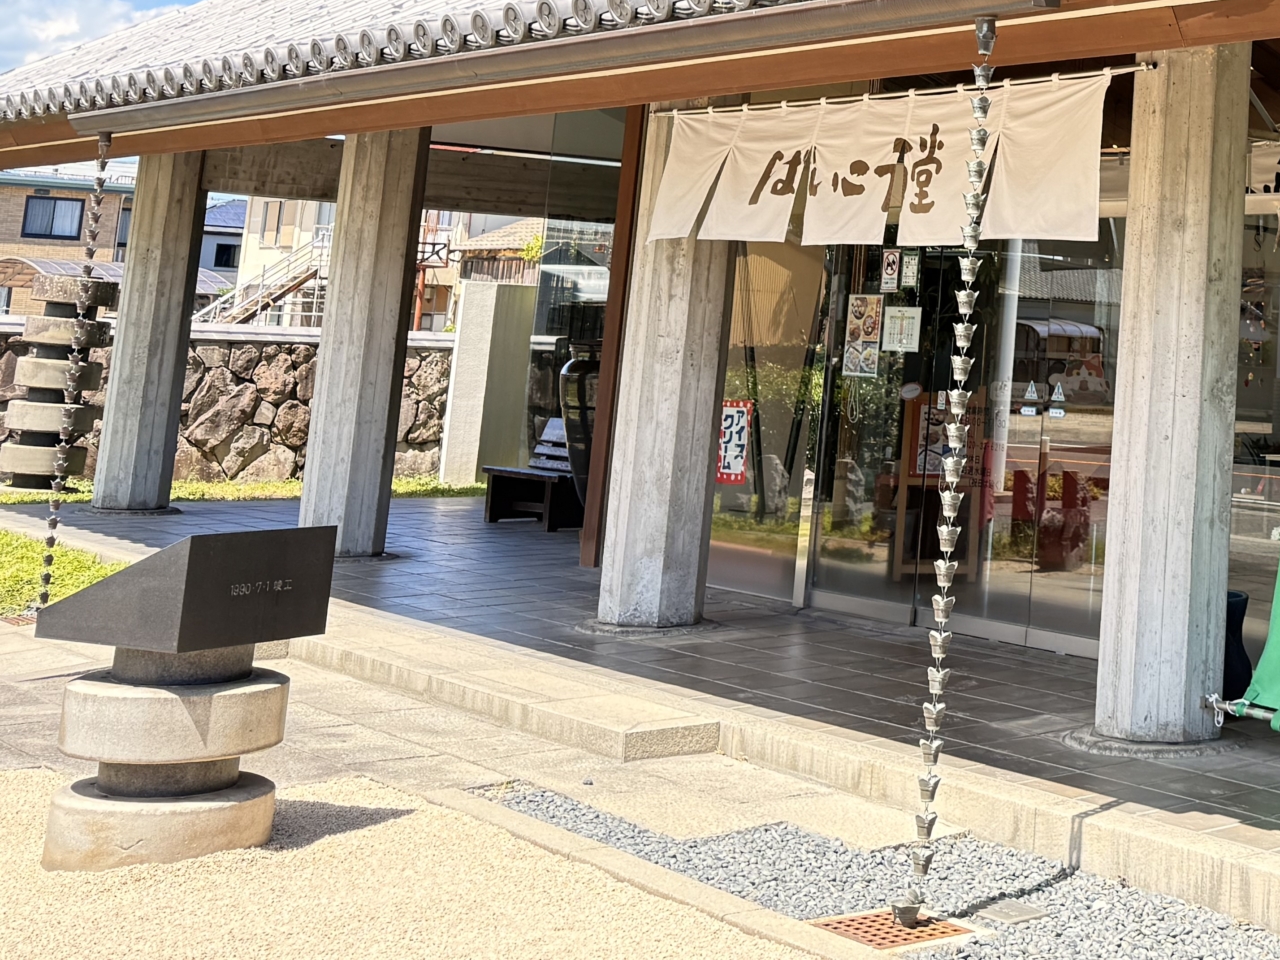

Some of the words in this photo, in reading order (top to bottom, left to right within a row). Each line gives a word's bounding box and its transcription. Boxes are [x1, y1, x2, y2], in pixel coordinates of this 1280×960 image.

[722, 414, 734, 470] クリーム
[734, 410, 746, 460] アイス
